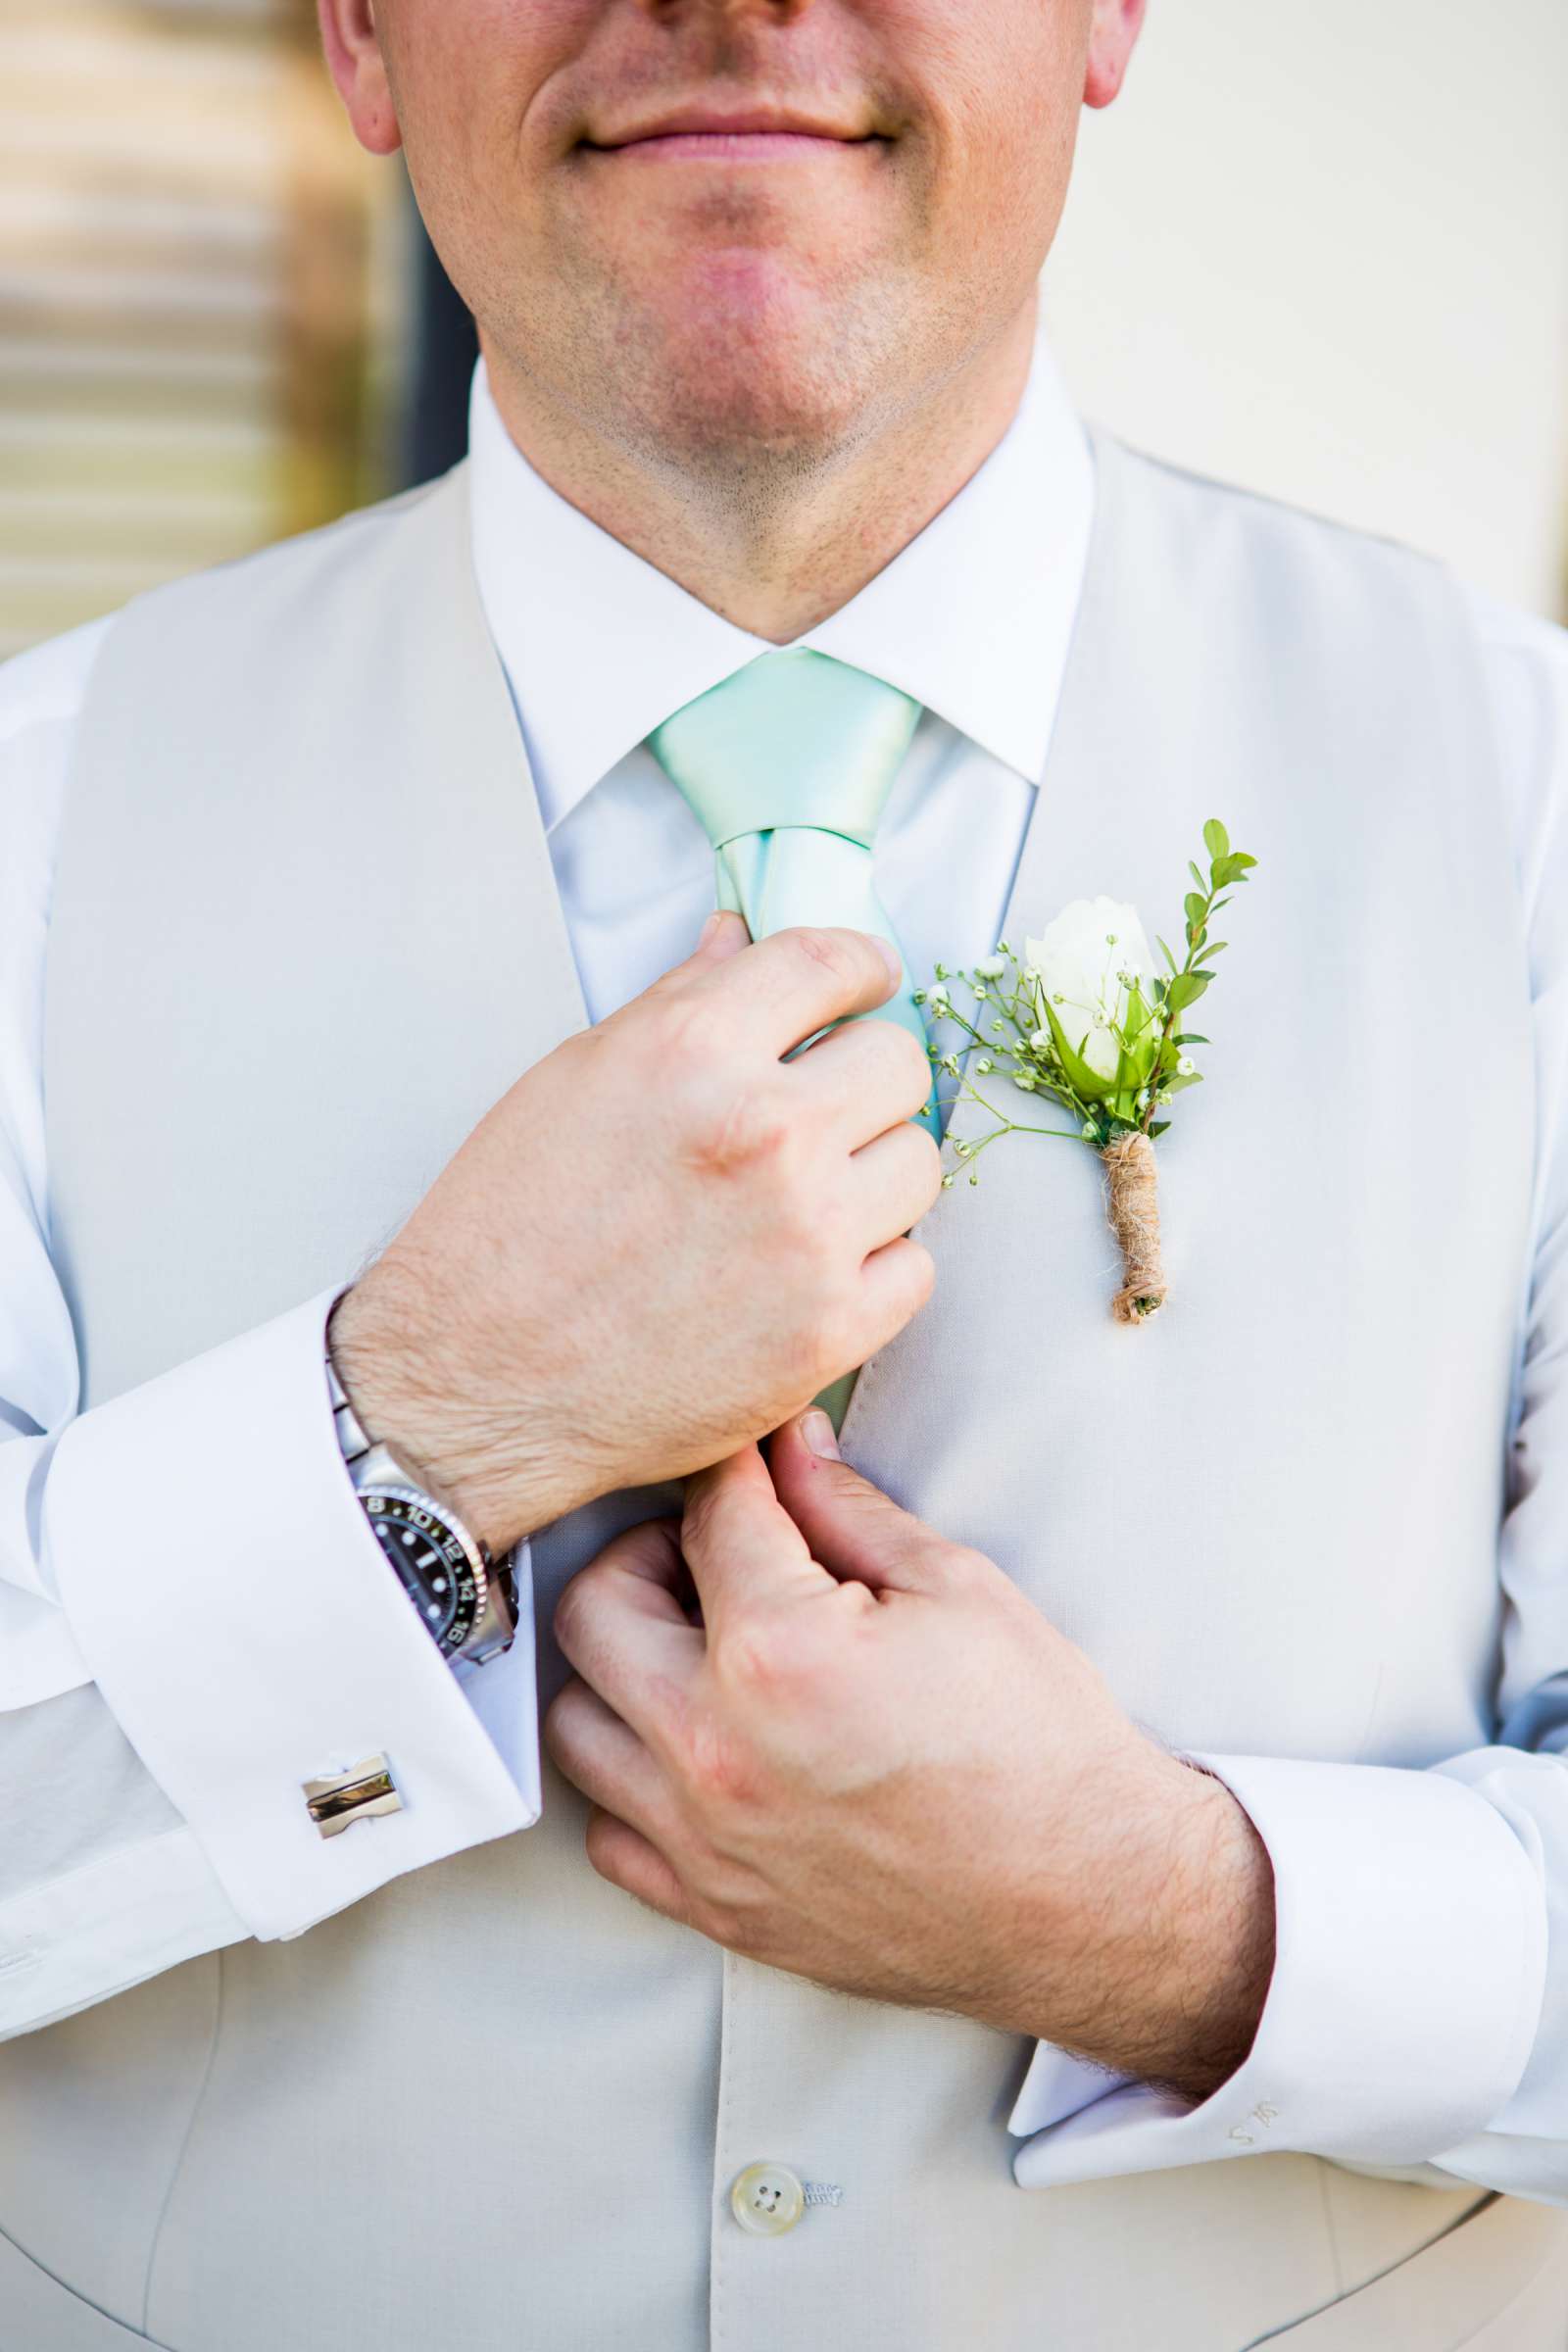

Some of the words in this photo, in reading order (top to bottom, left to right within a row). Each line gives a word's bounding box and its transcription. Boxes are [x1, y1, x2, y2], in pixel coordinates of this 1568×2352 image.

[367, 1496, 385, 1513] 8
[407, 1505, 433, 1529] 10
[442, 1535, 466, 1563] 12
[459, 1577, 476, 1601] 14
[447, 1621, 469, 1643] 16
